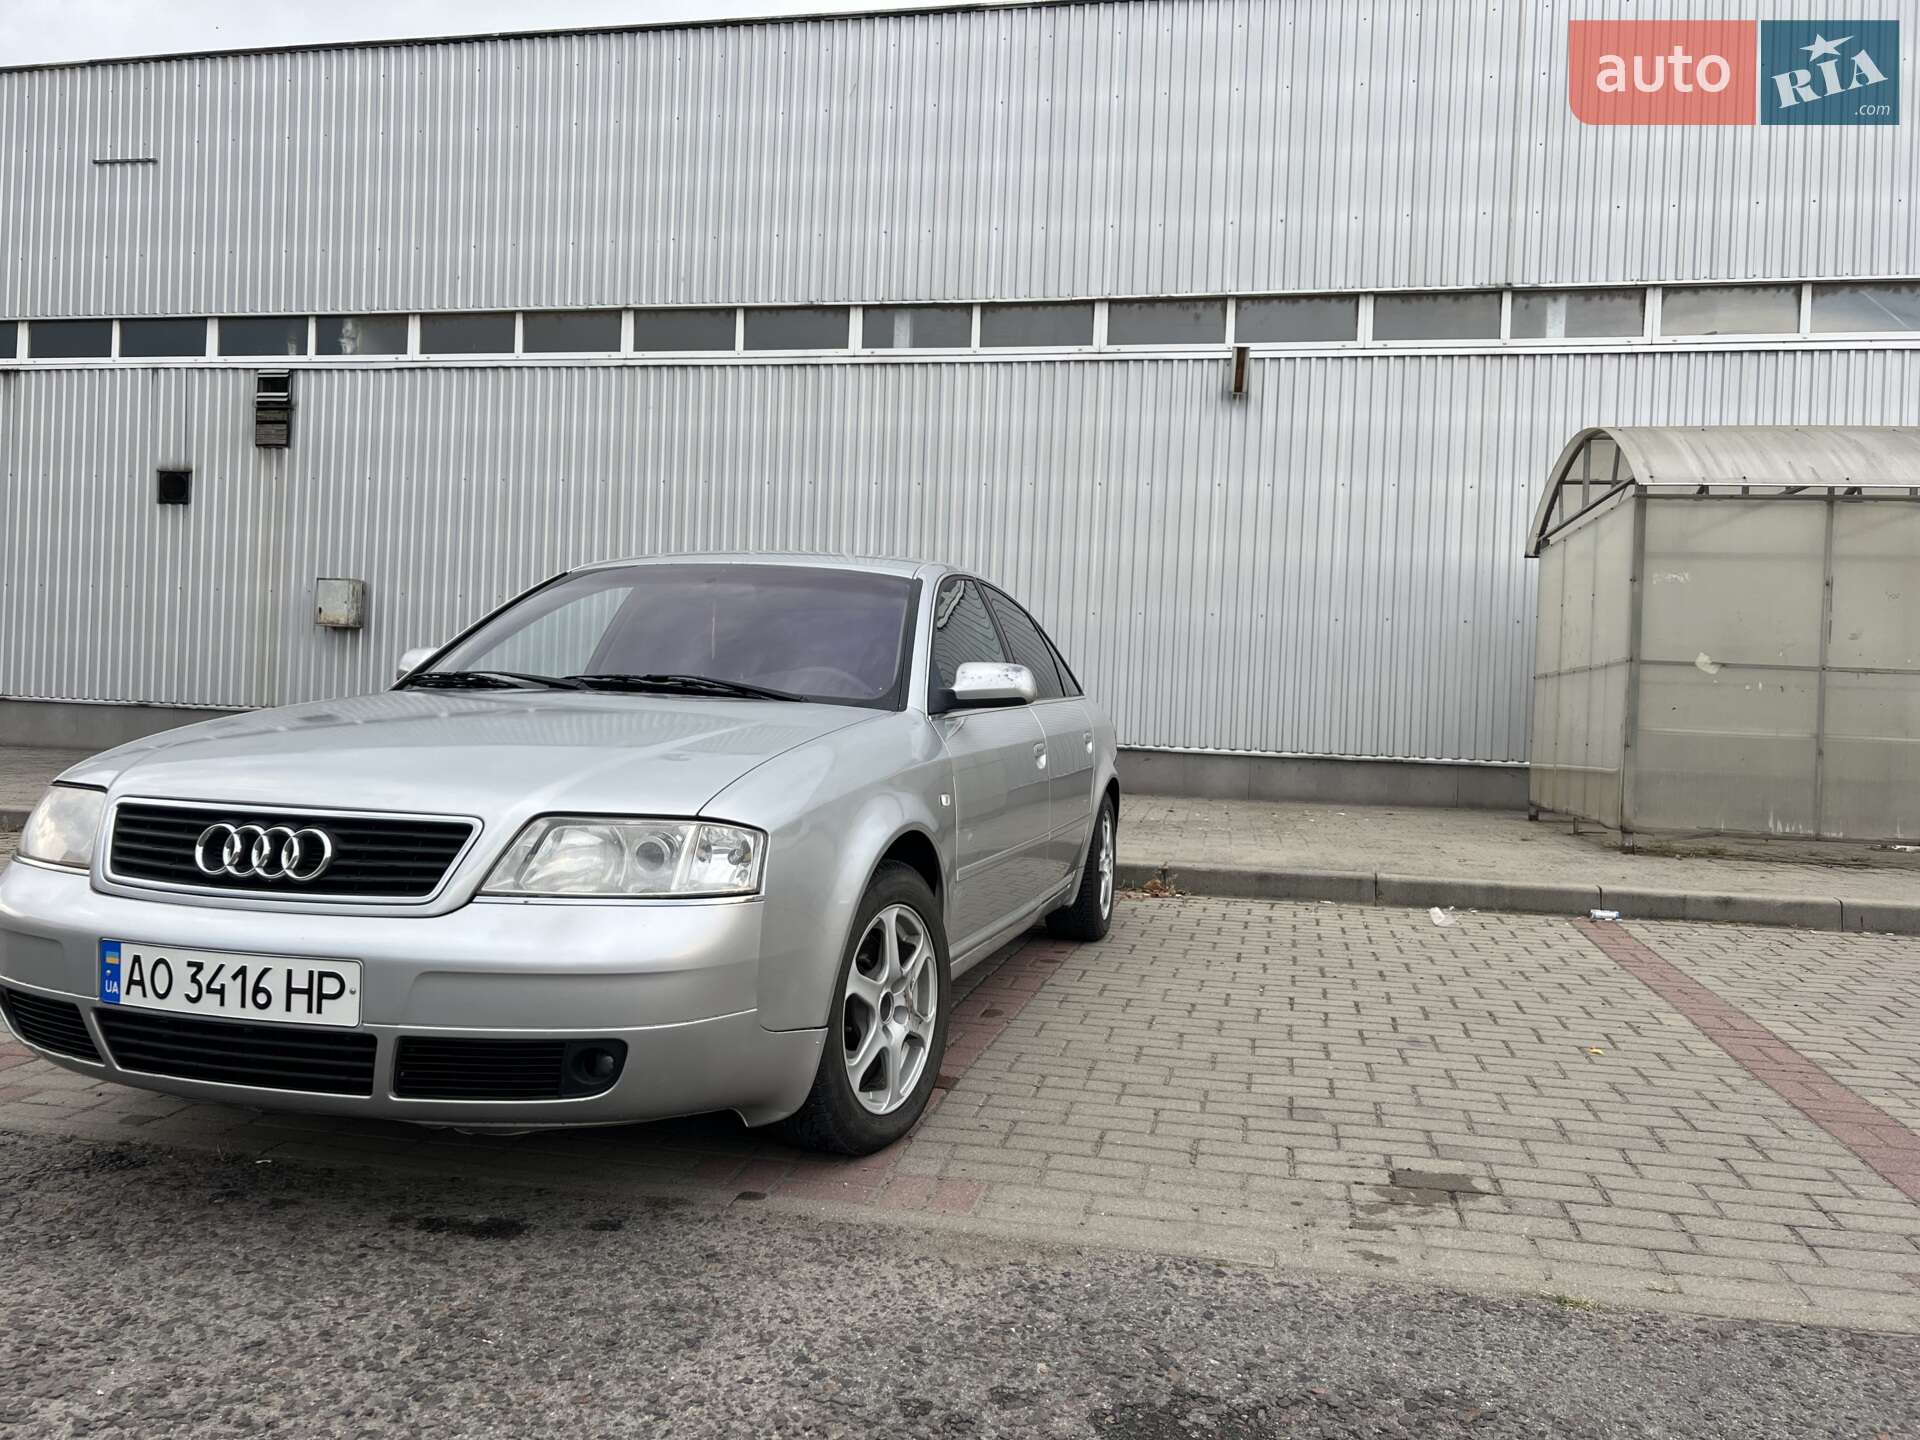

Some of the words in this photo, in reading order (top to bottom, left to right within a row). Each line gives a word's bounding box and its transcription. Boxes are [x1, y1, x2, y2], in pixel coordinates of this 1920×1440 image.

[105, 980, 119, 995] UA
[125, 954, 173, 1000] AO
[184, 960, 273, 1010] 3416
[284, 968, 346, 1015] HP
